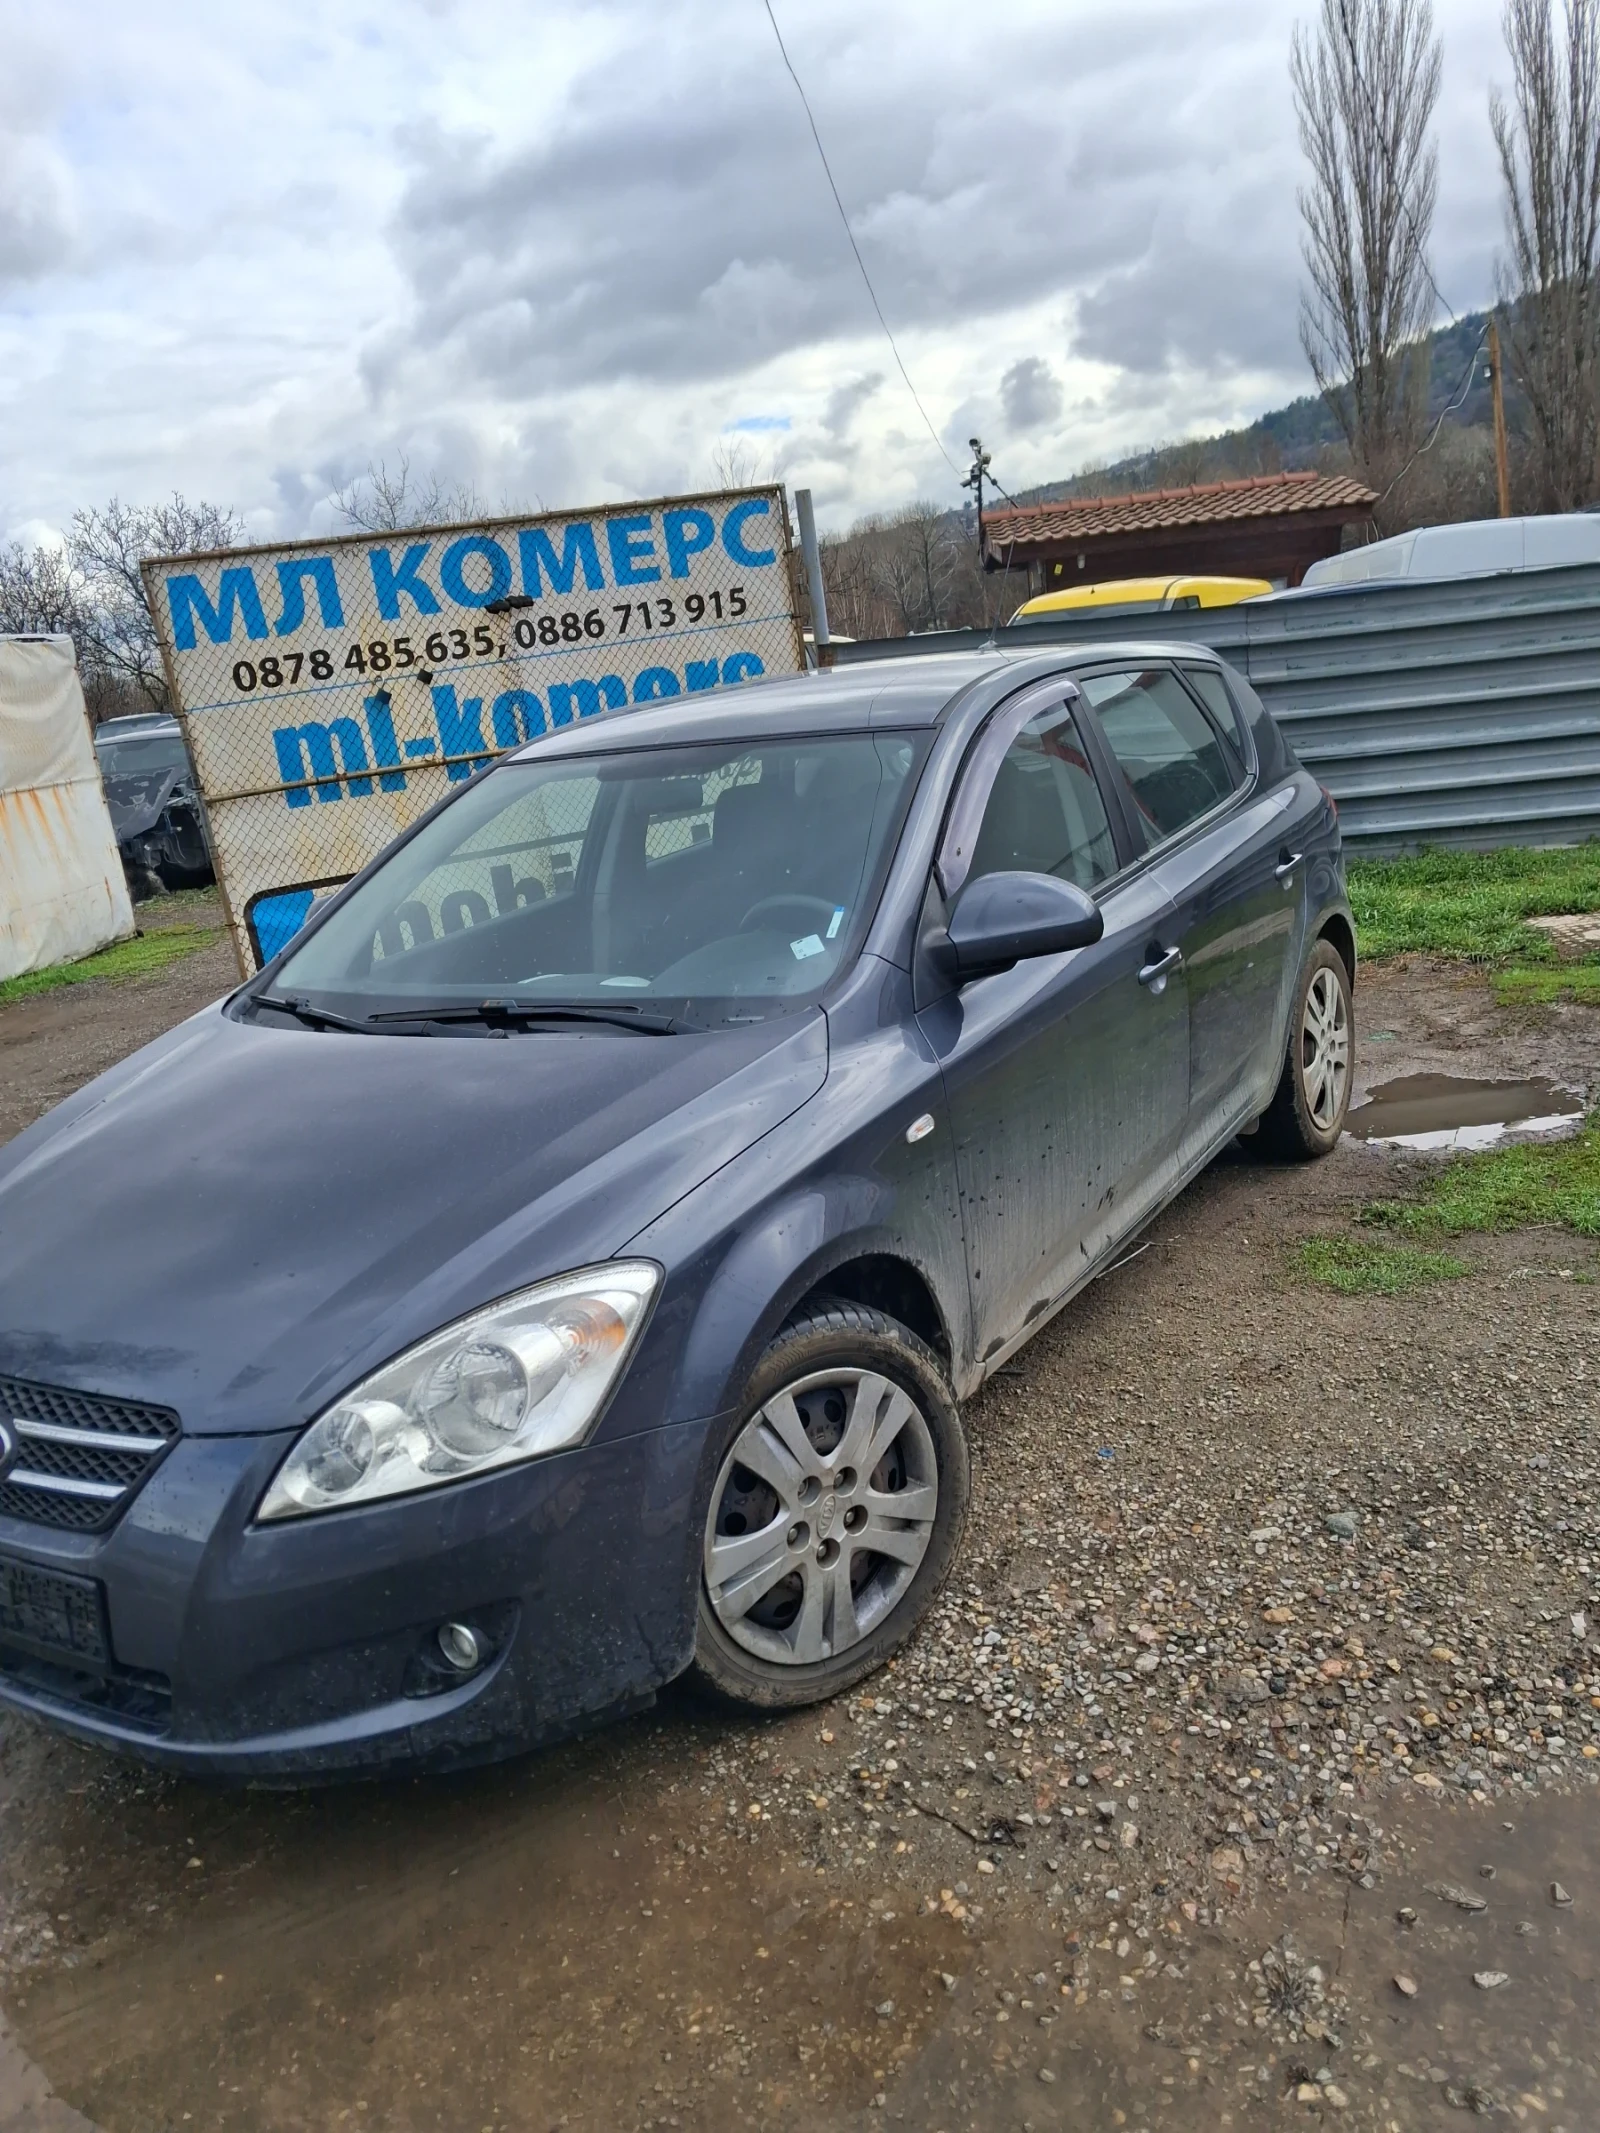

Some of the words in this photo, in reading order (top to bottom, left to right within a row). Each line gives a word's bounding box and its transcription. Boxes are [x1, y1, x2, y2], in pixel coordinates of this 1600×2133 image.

[166, 556, 345, 652] МЛ
[368, 499, 777, 621] КОМЕРС
[232, 649, 335, 693] 0878
[344, 637, 416, 675] 485
[425, 625, 506, 663] 635,
[514, 608, 605, 650] 0886
[613, 598, 677, 635] 713
[684, 587, 748, 624] 915
